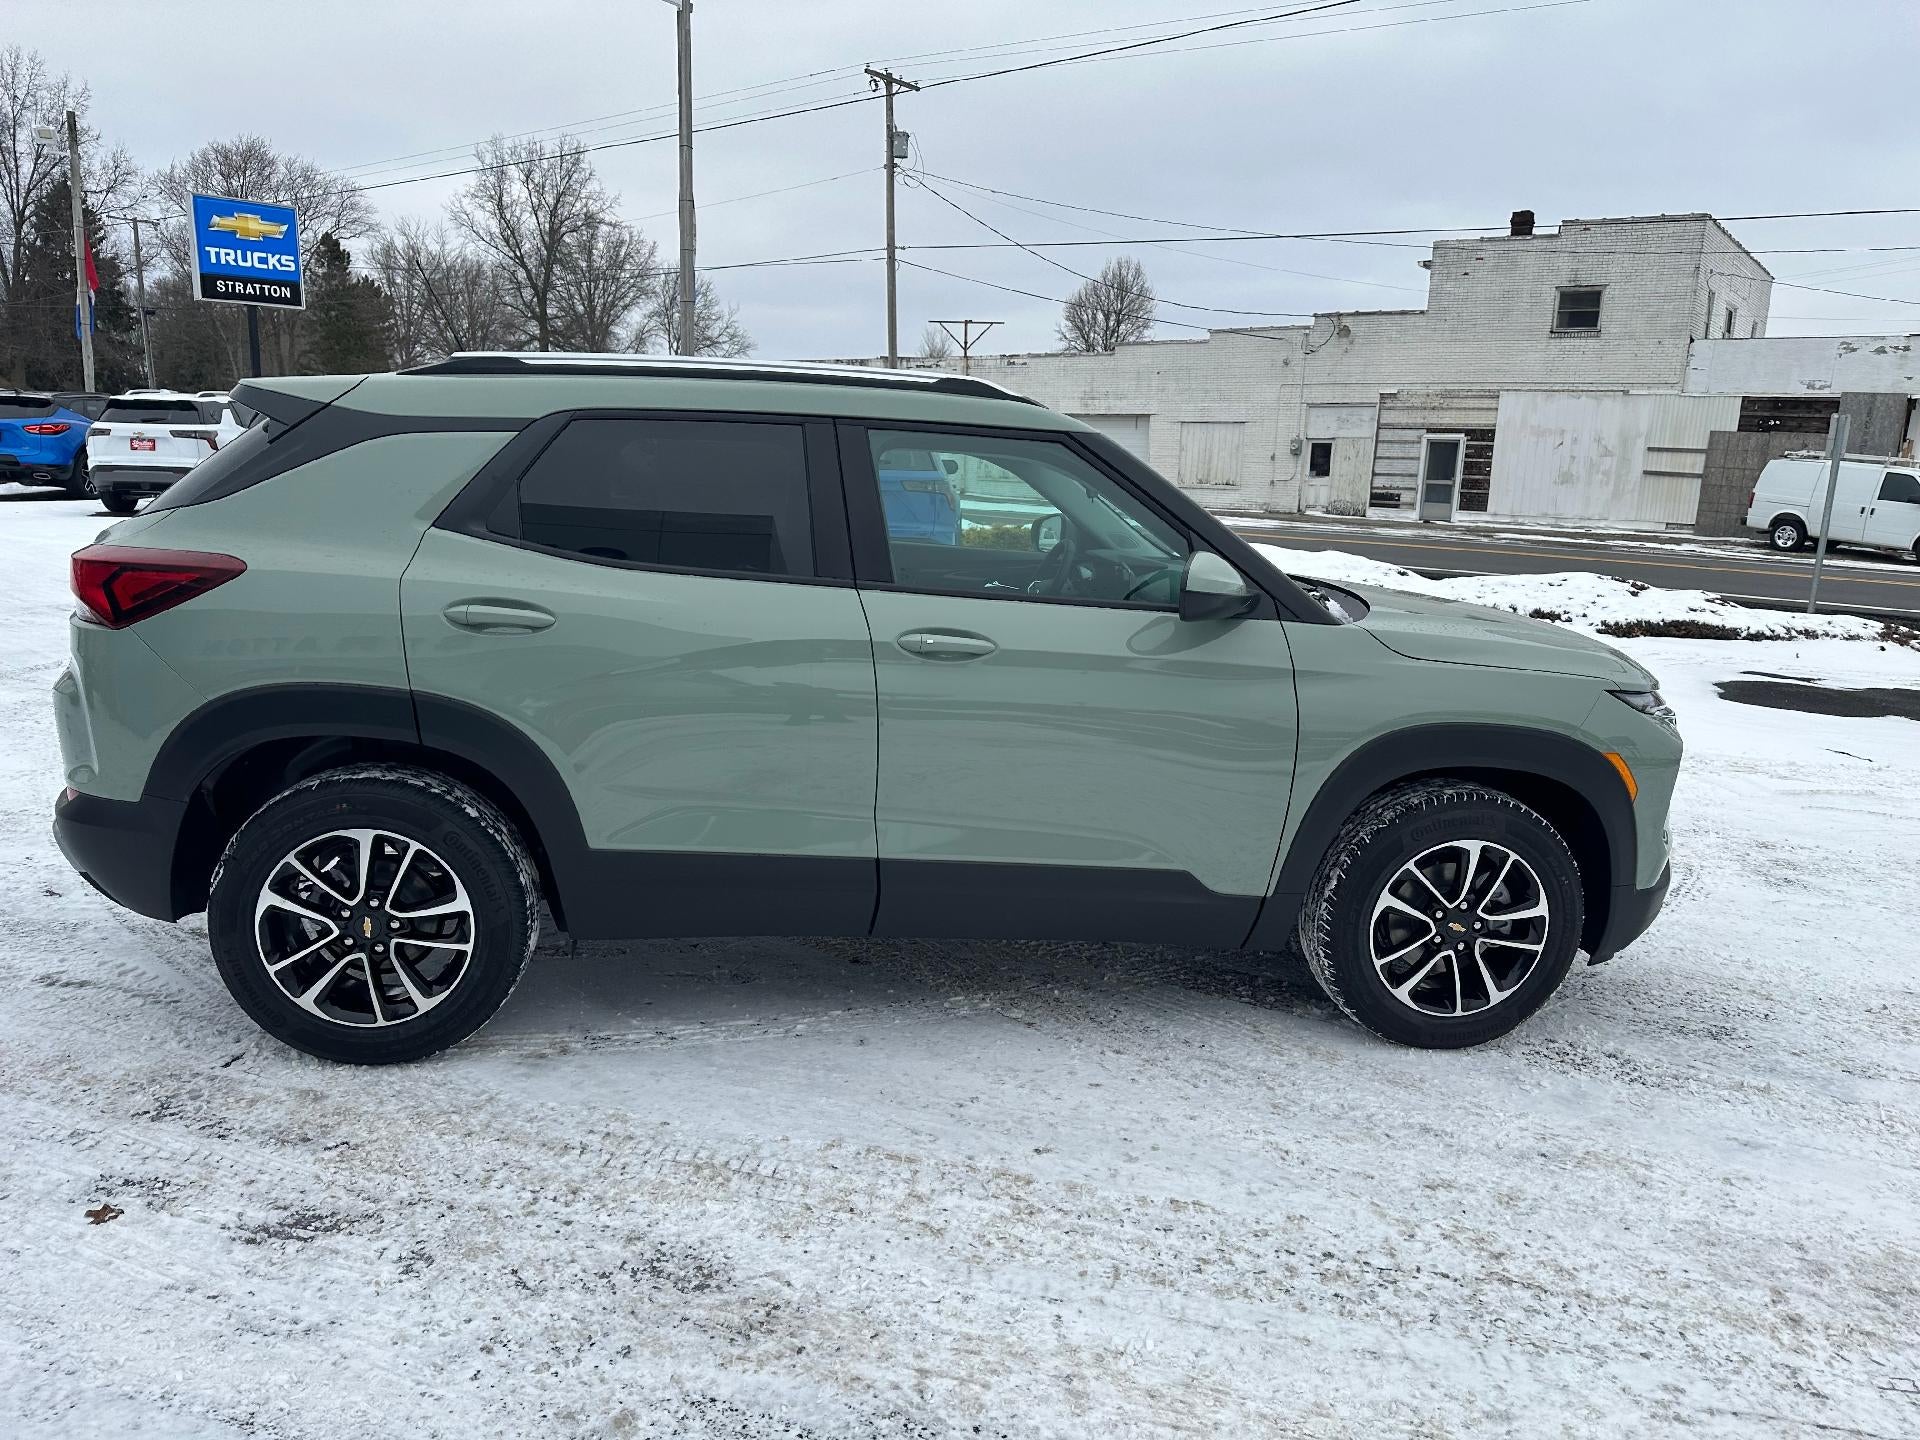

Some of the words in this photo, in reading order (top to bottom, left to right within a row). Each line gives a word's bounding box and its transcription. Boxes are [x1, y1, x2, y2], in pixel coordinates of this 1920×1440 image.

[204, 246, 296, 272] TRUCKS
[216, 280, 291, 298] STRATTON
[1410, 815, 1487, 841] Continental
[442, 830, 502, 905] Continental
